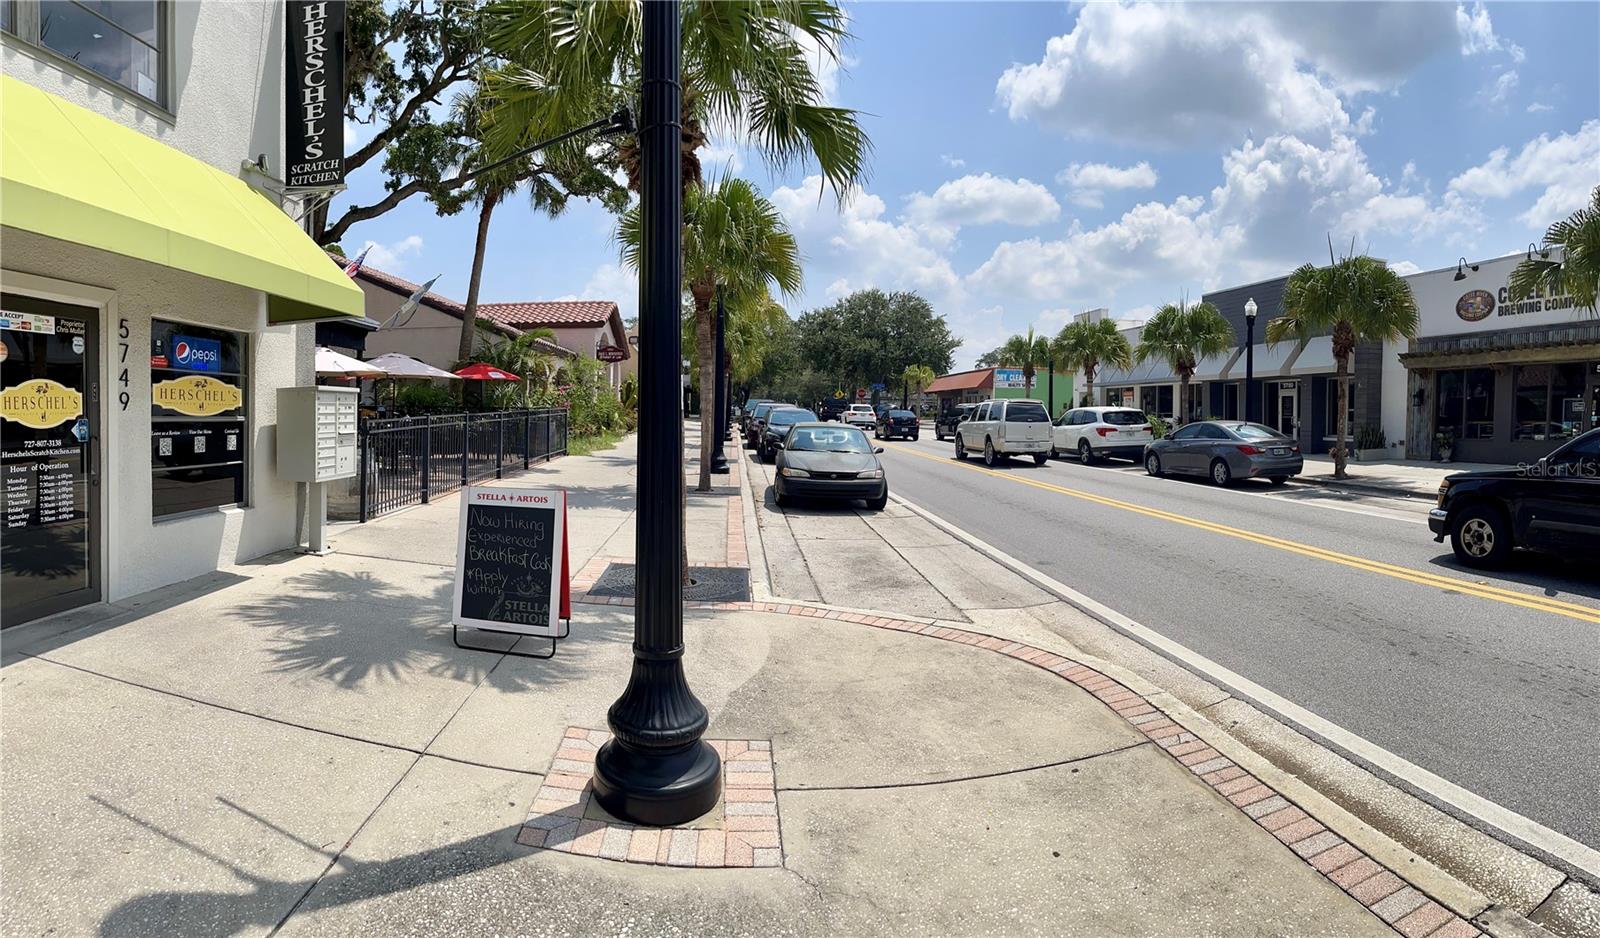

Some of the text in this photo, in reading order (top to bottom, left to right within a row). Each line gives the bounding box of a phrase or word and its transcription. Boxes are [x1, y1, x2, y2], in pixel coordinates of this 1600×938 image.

[302, 2, 328, 160] HERSCHEL'S
[291, 160, 339, 174] SCRATCH
[291, 171, 340, 185] KITCHEN
[1498, 300, 1541, 316] BREWING
[192, 350, 216, 363] pepsi
[119, 319, 130, 410] 5749
[160, 388, 238, 402] HERSCHEL'S
[4, 396, 78, 410] HERSCHEL'S
[24, 440, 61, 448] 727-807-3138
[39, 462, 69, 471] Operation
[470, 508, 500, 528] Now
[530, 552, 552, 574] Cook
[505, 600, 549, 613] STELLA
[504, 611, 549, 624] ARTOIS
